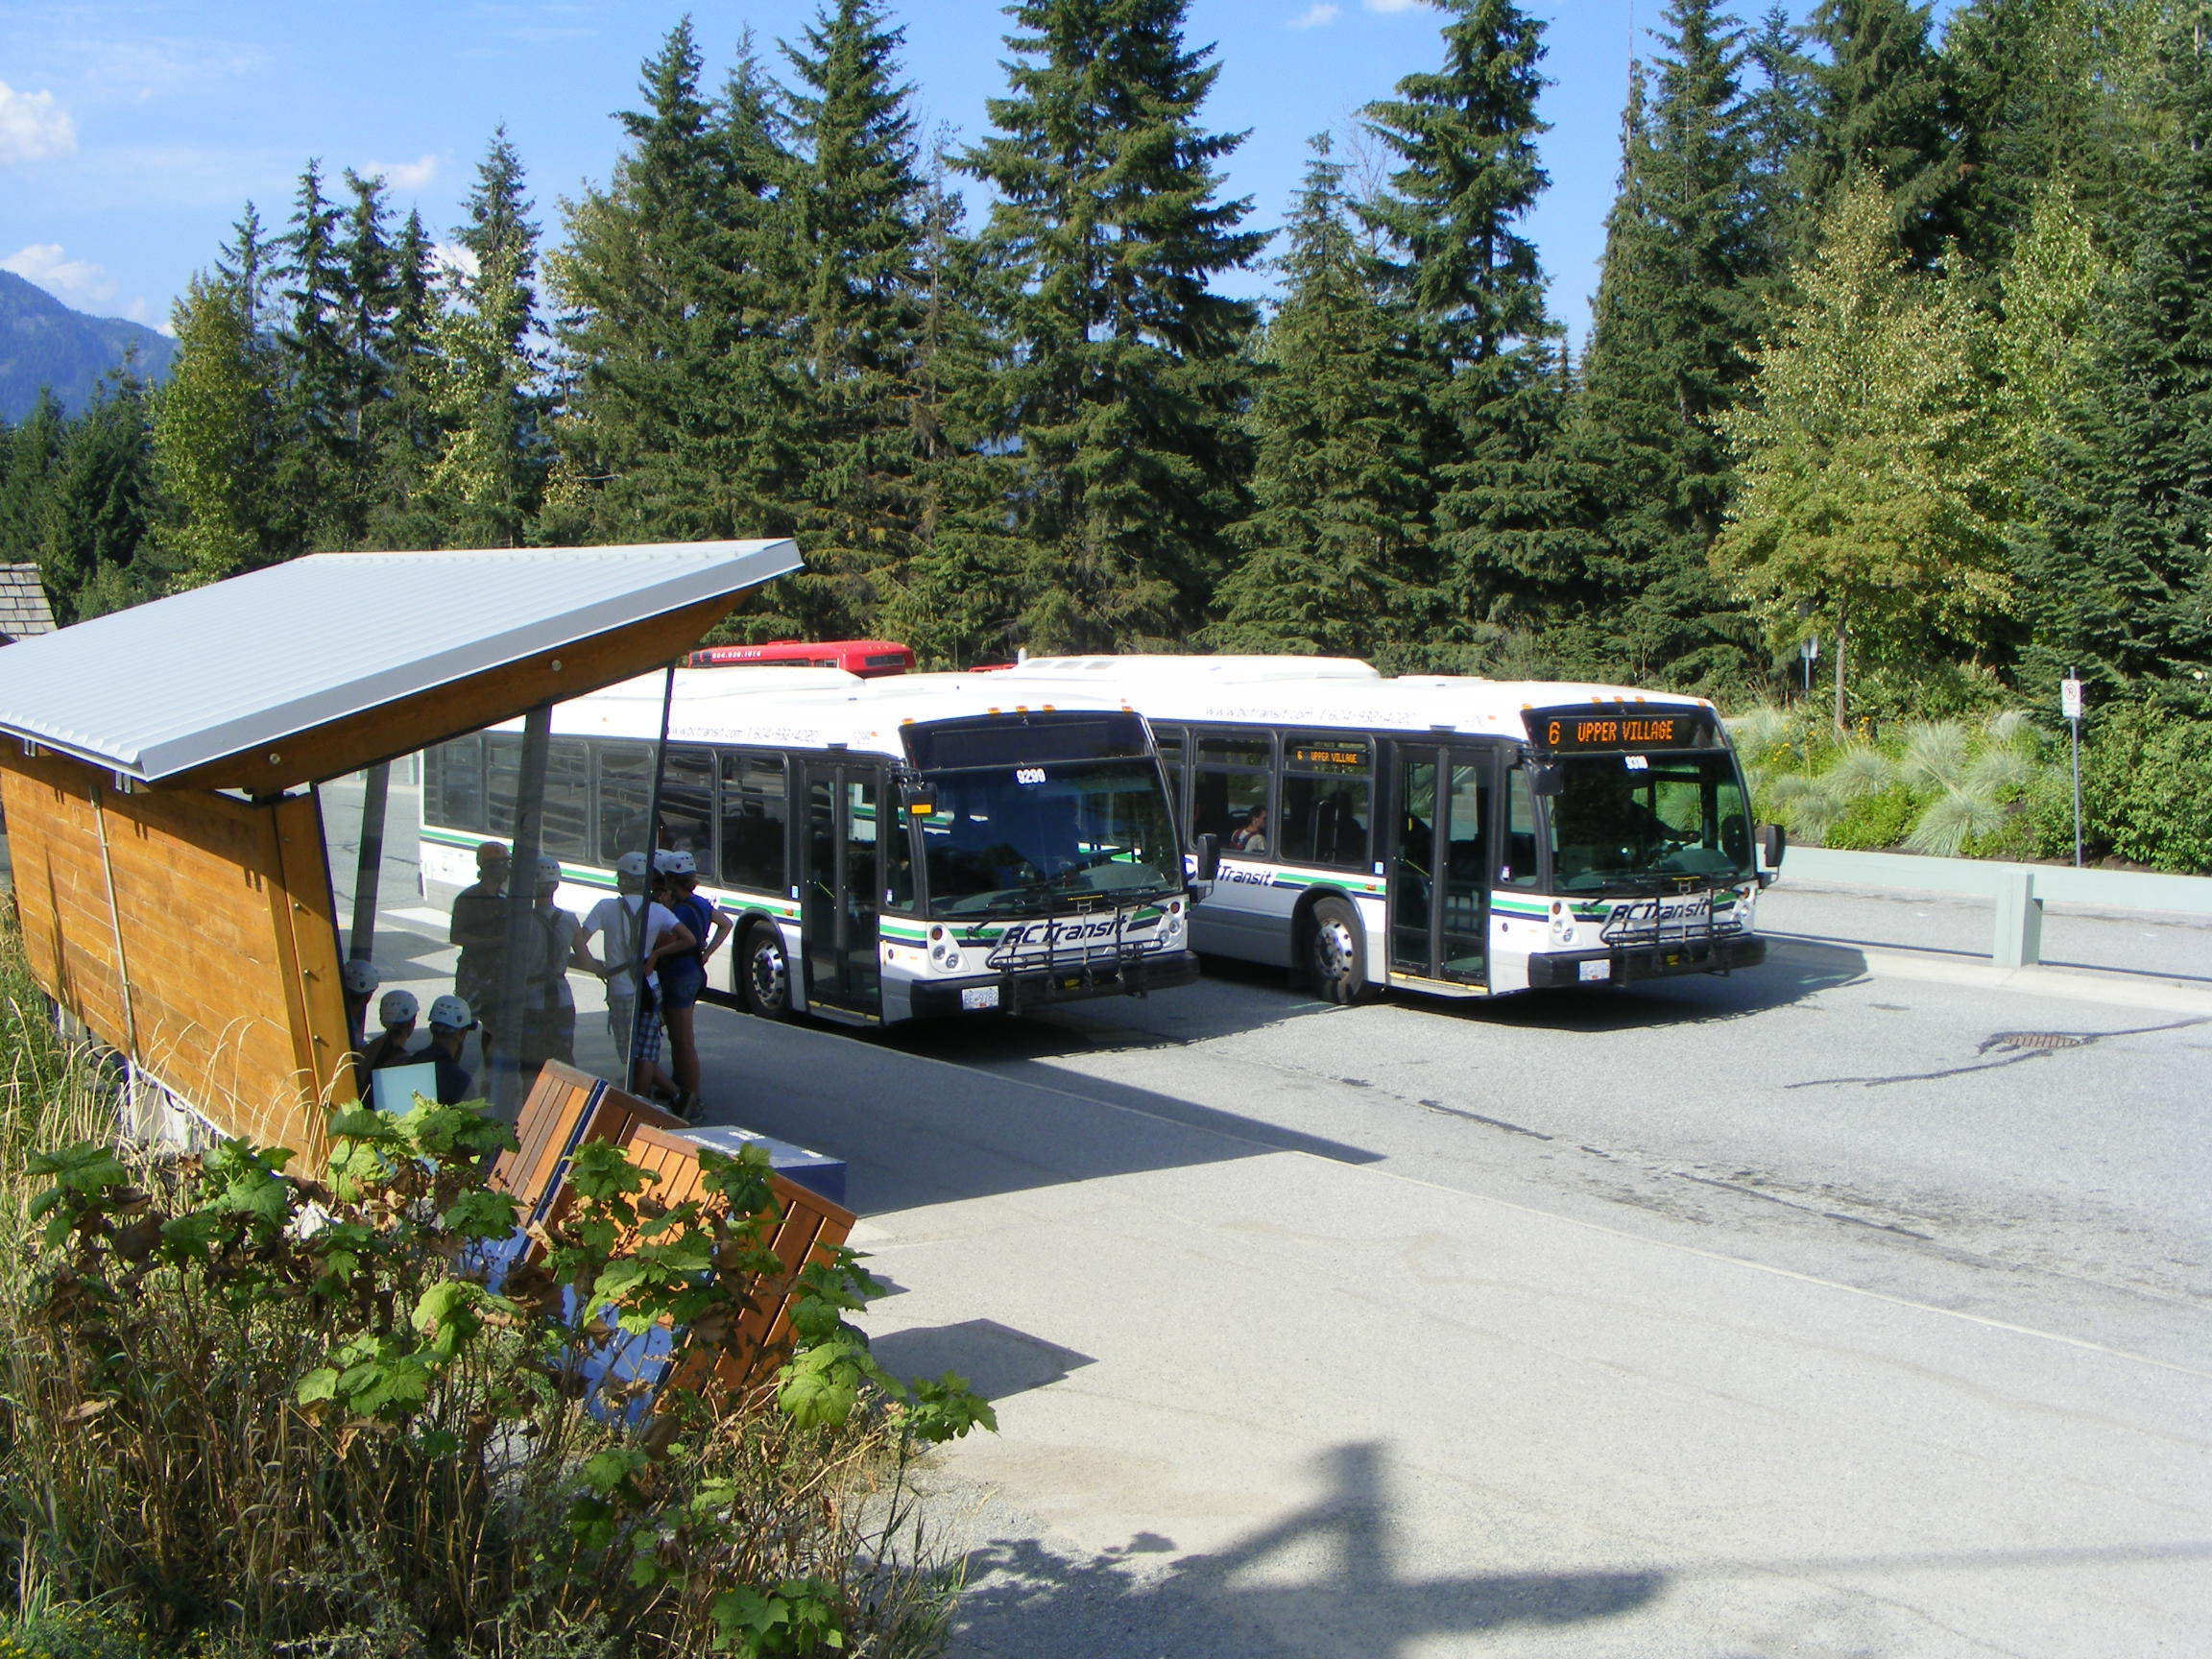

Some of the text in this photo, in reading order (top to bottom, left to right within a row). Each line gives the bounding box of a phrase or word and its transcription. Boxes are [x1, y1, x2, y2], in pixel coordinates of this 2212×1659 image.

[1548, 720, 1673, 745] 6 UPPER VILLAGE
[1297, 750, 1358, 764] 6 UPPER VILLAGE
[1016, 768, 1046, 784] 9299
